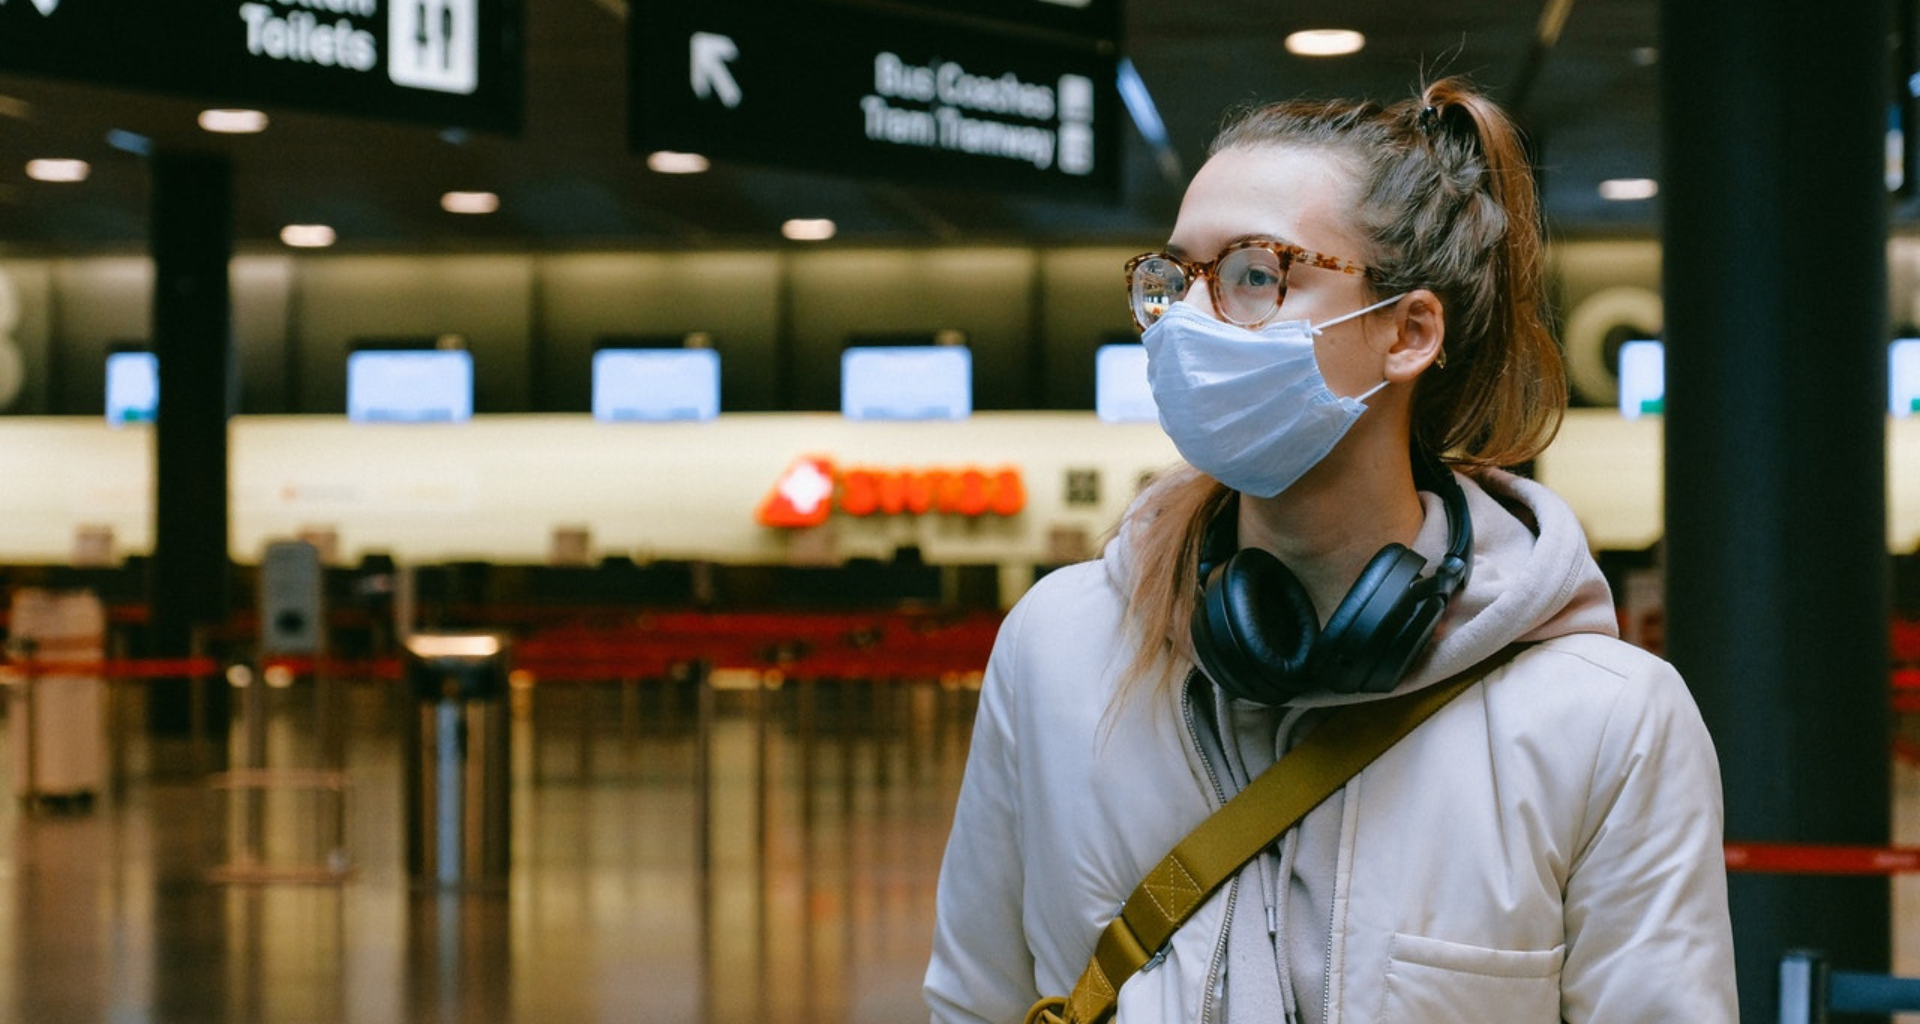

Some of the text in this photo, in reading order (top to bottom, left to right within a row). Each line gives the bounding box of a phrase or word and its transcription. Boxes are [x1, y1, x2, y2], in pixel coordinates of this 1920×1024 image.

[241, 3, 376, 70] Toilets
[875, 53, 1054, 120] Bus Coaches
[861, 96, 1055, 169] Tram Tramway
